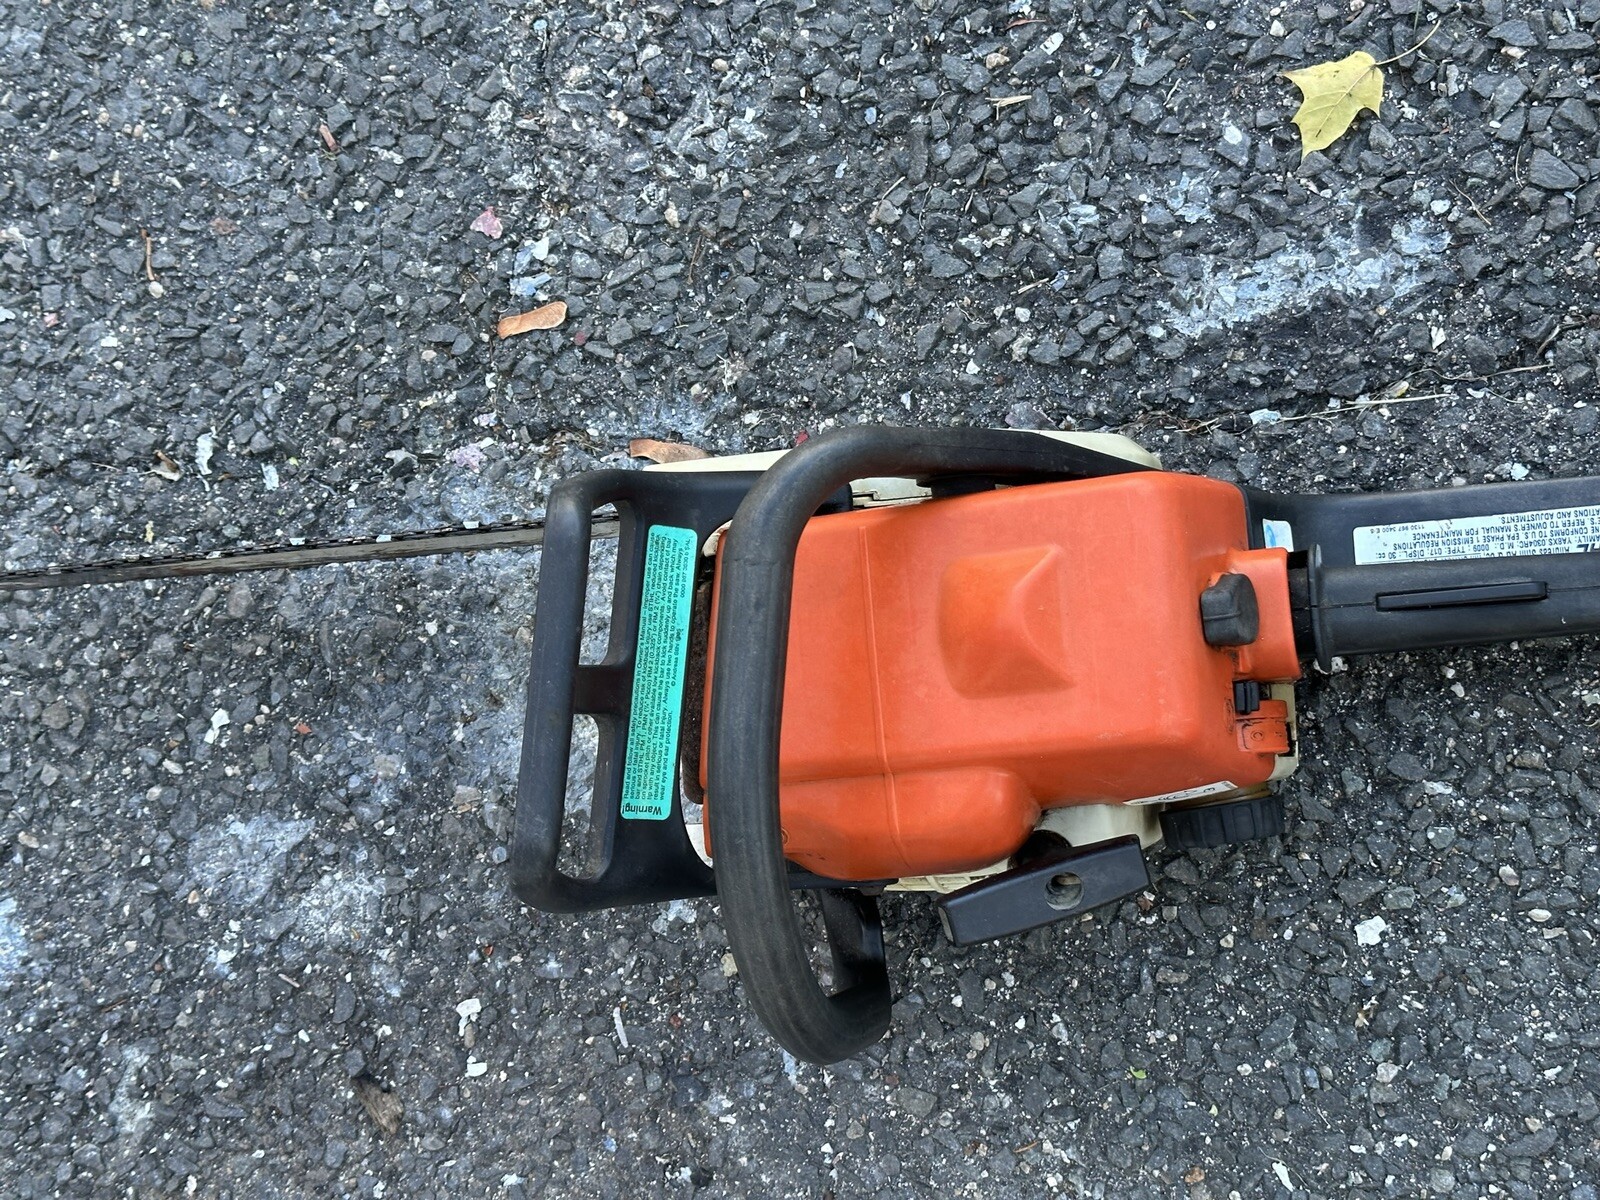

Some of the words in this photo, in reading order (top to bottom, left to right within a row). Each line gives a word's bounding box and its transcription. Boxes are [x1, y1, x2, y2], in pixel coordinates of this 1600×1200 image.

[1499, 512, 1554, 524] ADJUSTMENTS.
[1556, 510, 1572, 519] AND
[1514, 522, 1547, 532] OWNER'S
[1550, 521, 1559, 529] TO
[1561, 518, 1585, 528] REFER
[1412, 529, 1462, 540] MAINTENANCE
[1465, 528, 1478, 536] FOR
[1481, 525, 1511, 535] MANUAL
[1538, 530, 1547, 538] TO
[1550, 527, 1588, 537] CONFORMS
[1482, 534, 1504, 543] PHASE
[1506, 533, 1520, 541] EPA
[1522, 531, 1536, 540] U.S.
[1574, 535, 1600, 544] AMILY:
[1393, 540, 1439, 550] REGULATIONS
[1441, 537, 1474, 546] EMISSION
[622, 803, 663, 815] Warning!
